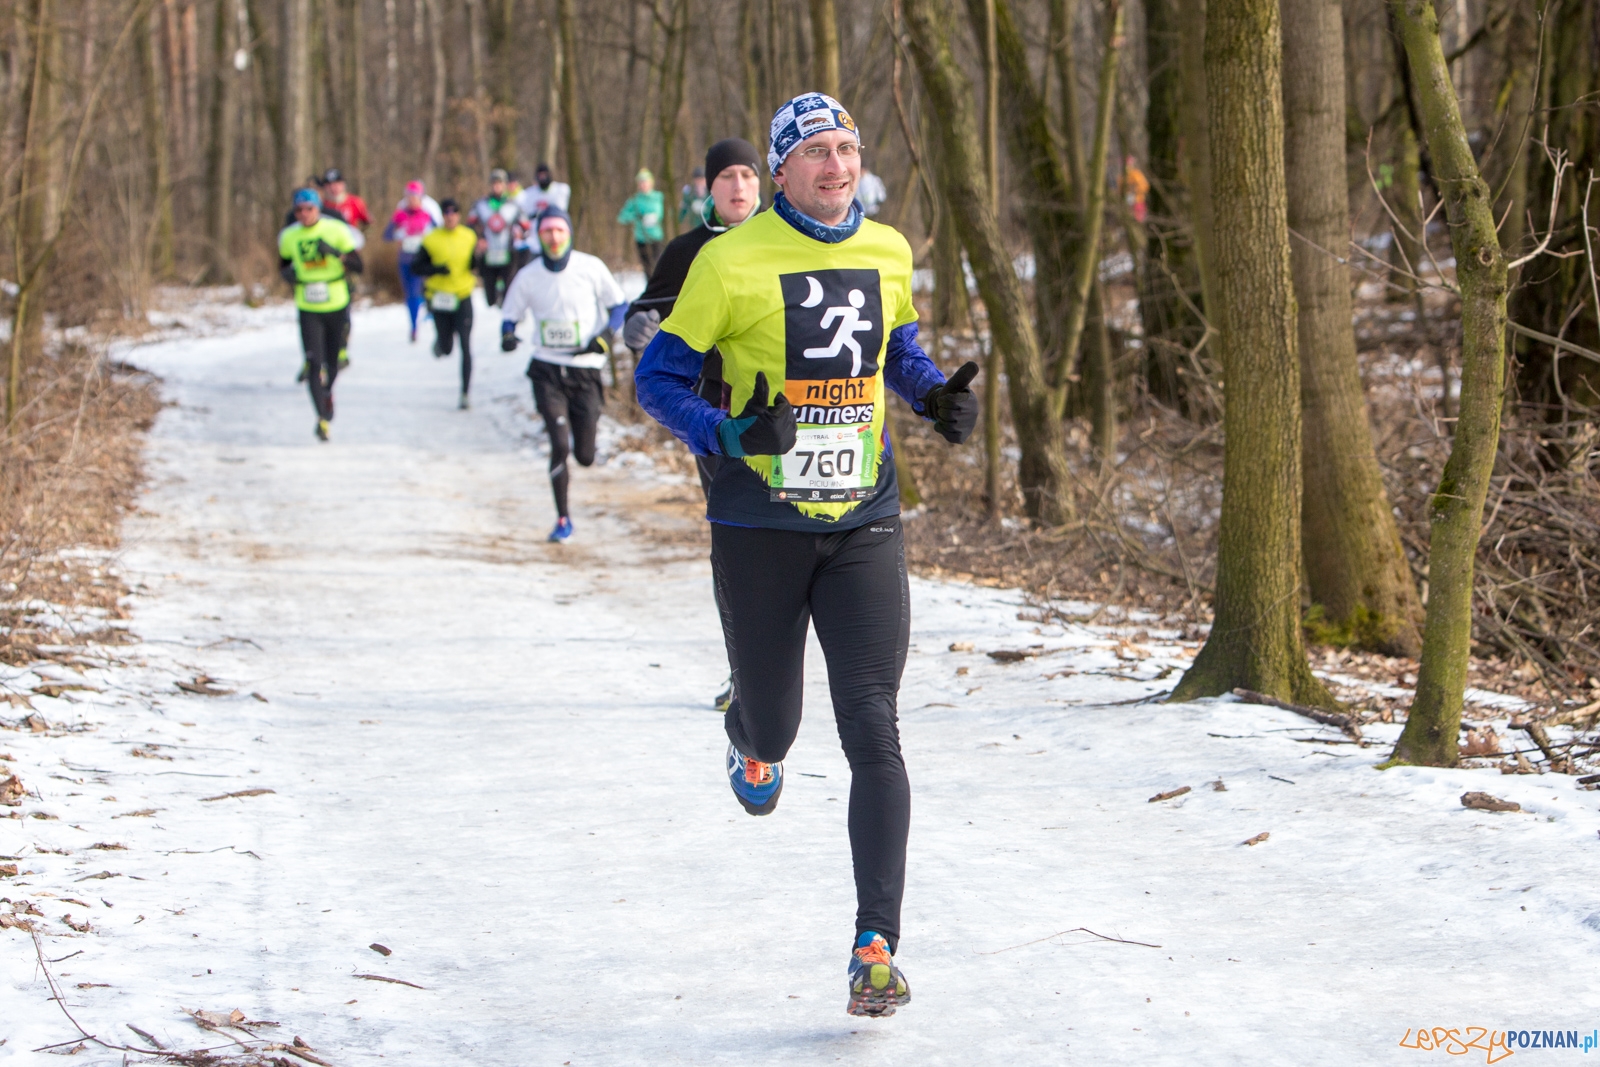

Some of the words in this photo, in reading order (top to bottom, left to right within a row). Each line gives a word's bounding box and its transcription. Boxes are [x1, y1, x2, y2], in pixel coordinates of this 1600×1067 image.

[806, 379, 865, 406] night
[793, 405, 873, 423] unners
[795, 449, 855, 478] 760
